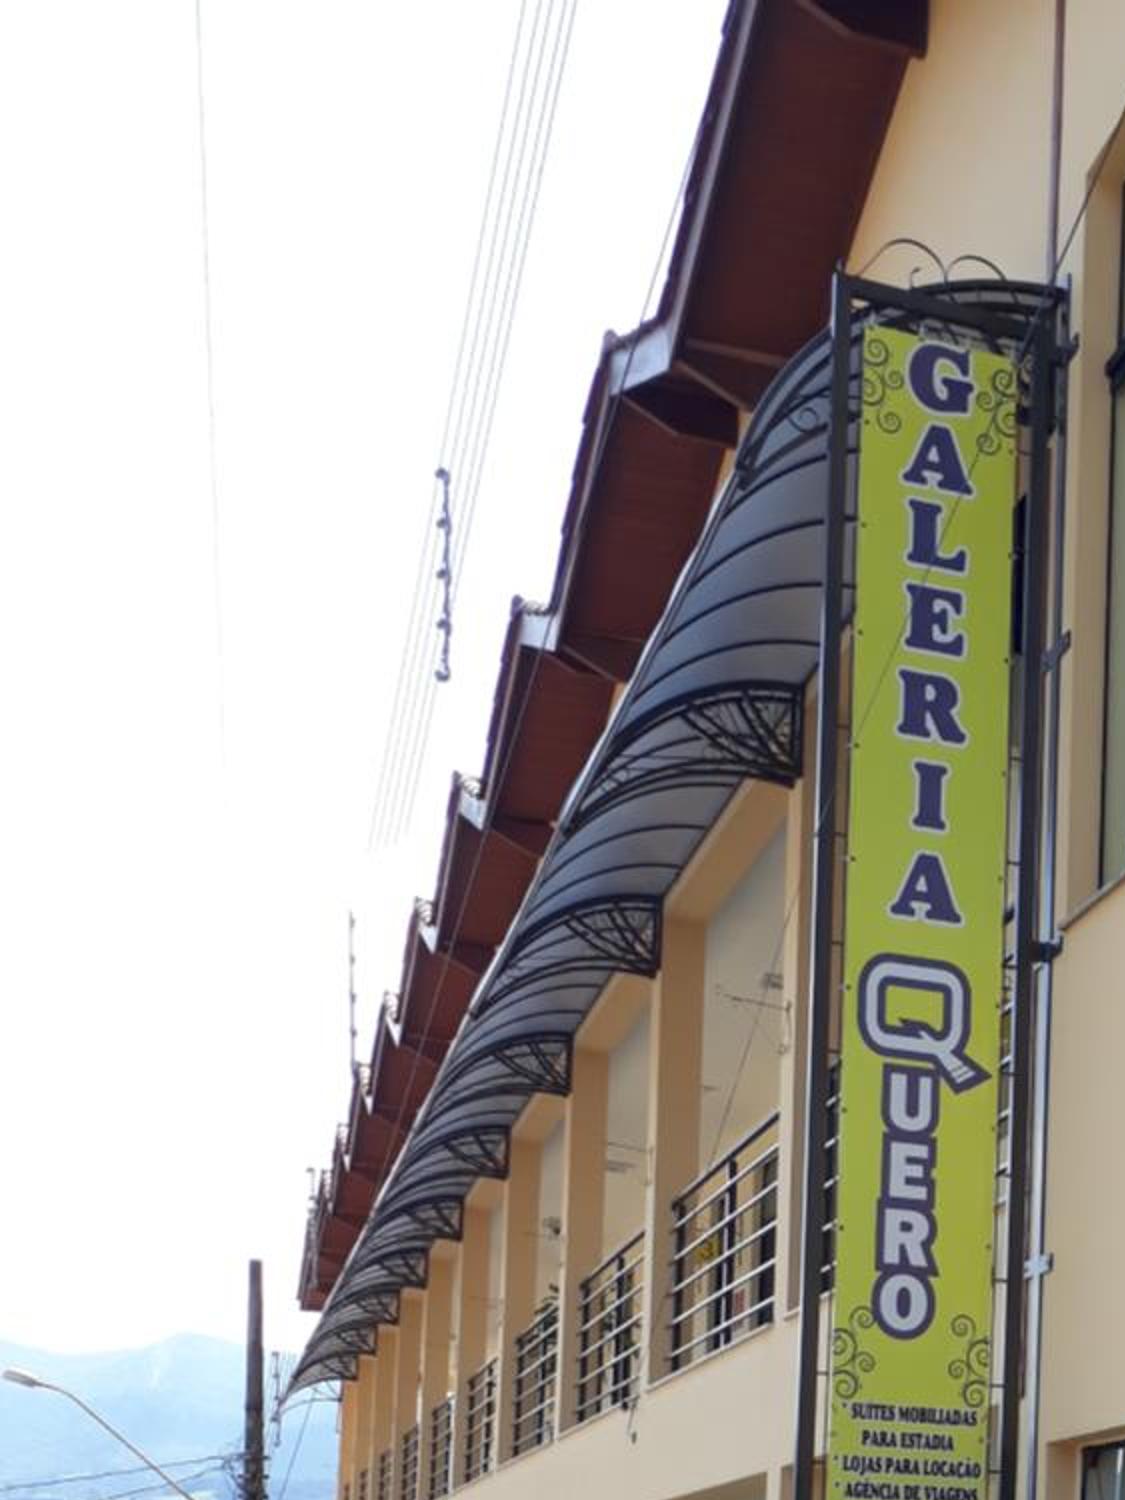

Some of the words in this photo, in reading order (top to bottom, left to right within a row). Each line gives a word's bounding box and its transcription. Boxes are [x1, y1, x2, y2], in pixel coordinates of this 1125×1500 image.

[889, 342, 976, 925] GALERIA
[857, 953, 992, 1340] QUERO
[852, 1402, 896, 1421] SUITES
[862, 1429, 897, 1448] PARA
[901, 1432, 954, 1451] ESTADIA
[843, 1455, 882, 1475] LOJAS
[886, 1457, 920, 1475] PARA
[904, 1485, 920, 1500] DE
